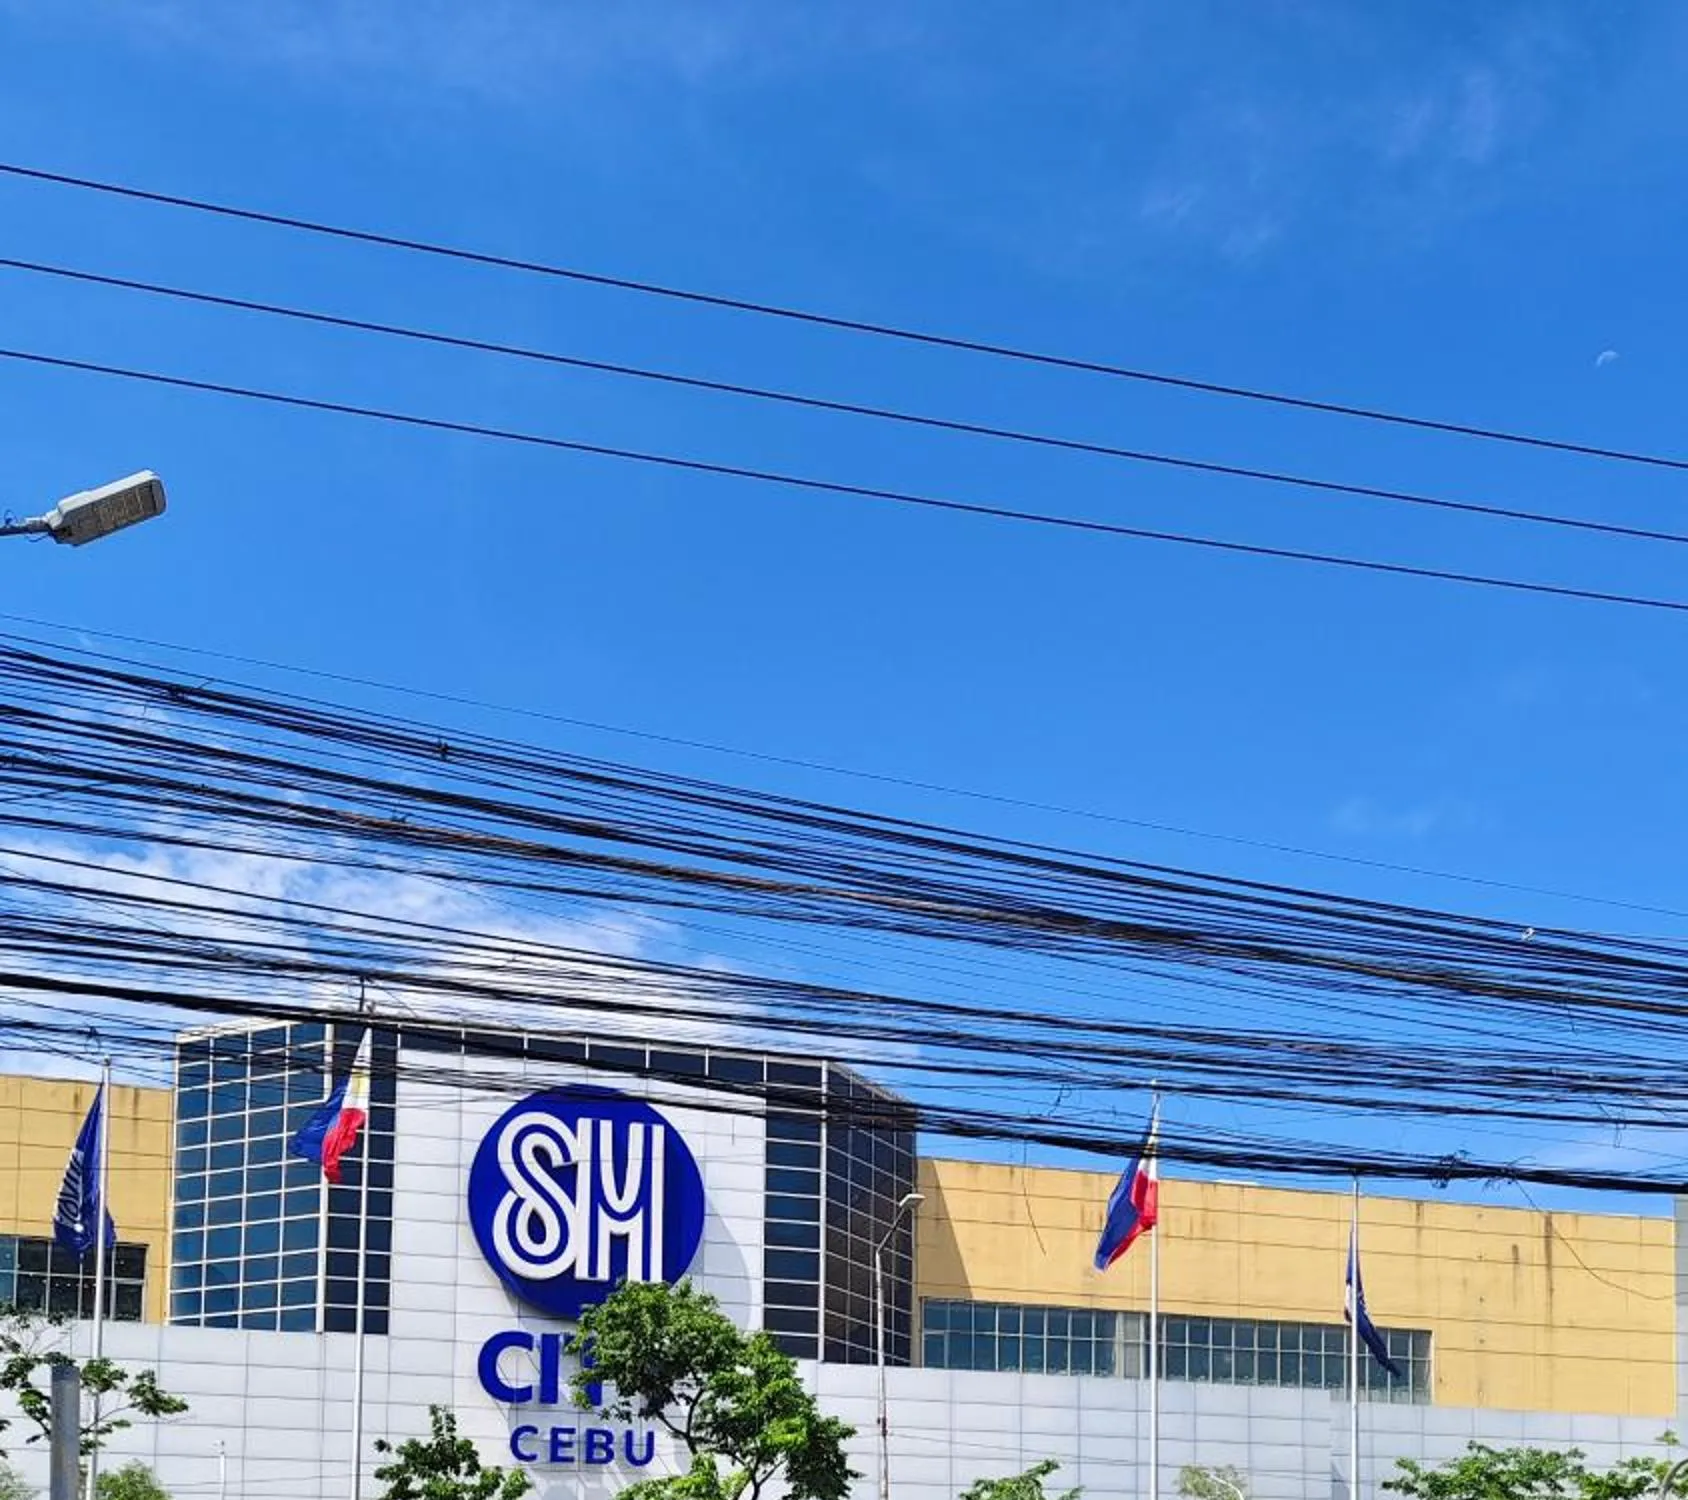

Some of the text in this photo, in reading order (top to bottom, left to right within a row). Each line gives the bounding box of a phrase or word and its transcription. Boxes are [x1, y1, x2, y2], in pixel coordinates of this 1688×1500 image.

[493, 1111, 665, 1282] SM
[477, 1330, 603, 1406] CIT
[509, 1424, 655, 1467] CEBU
